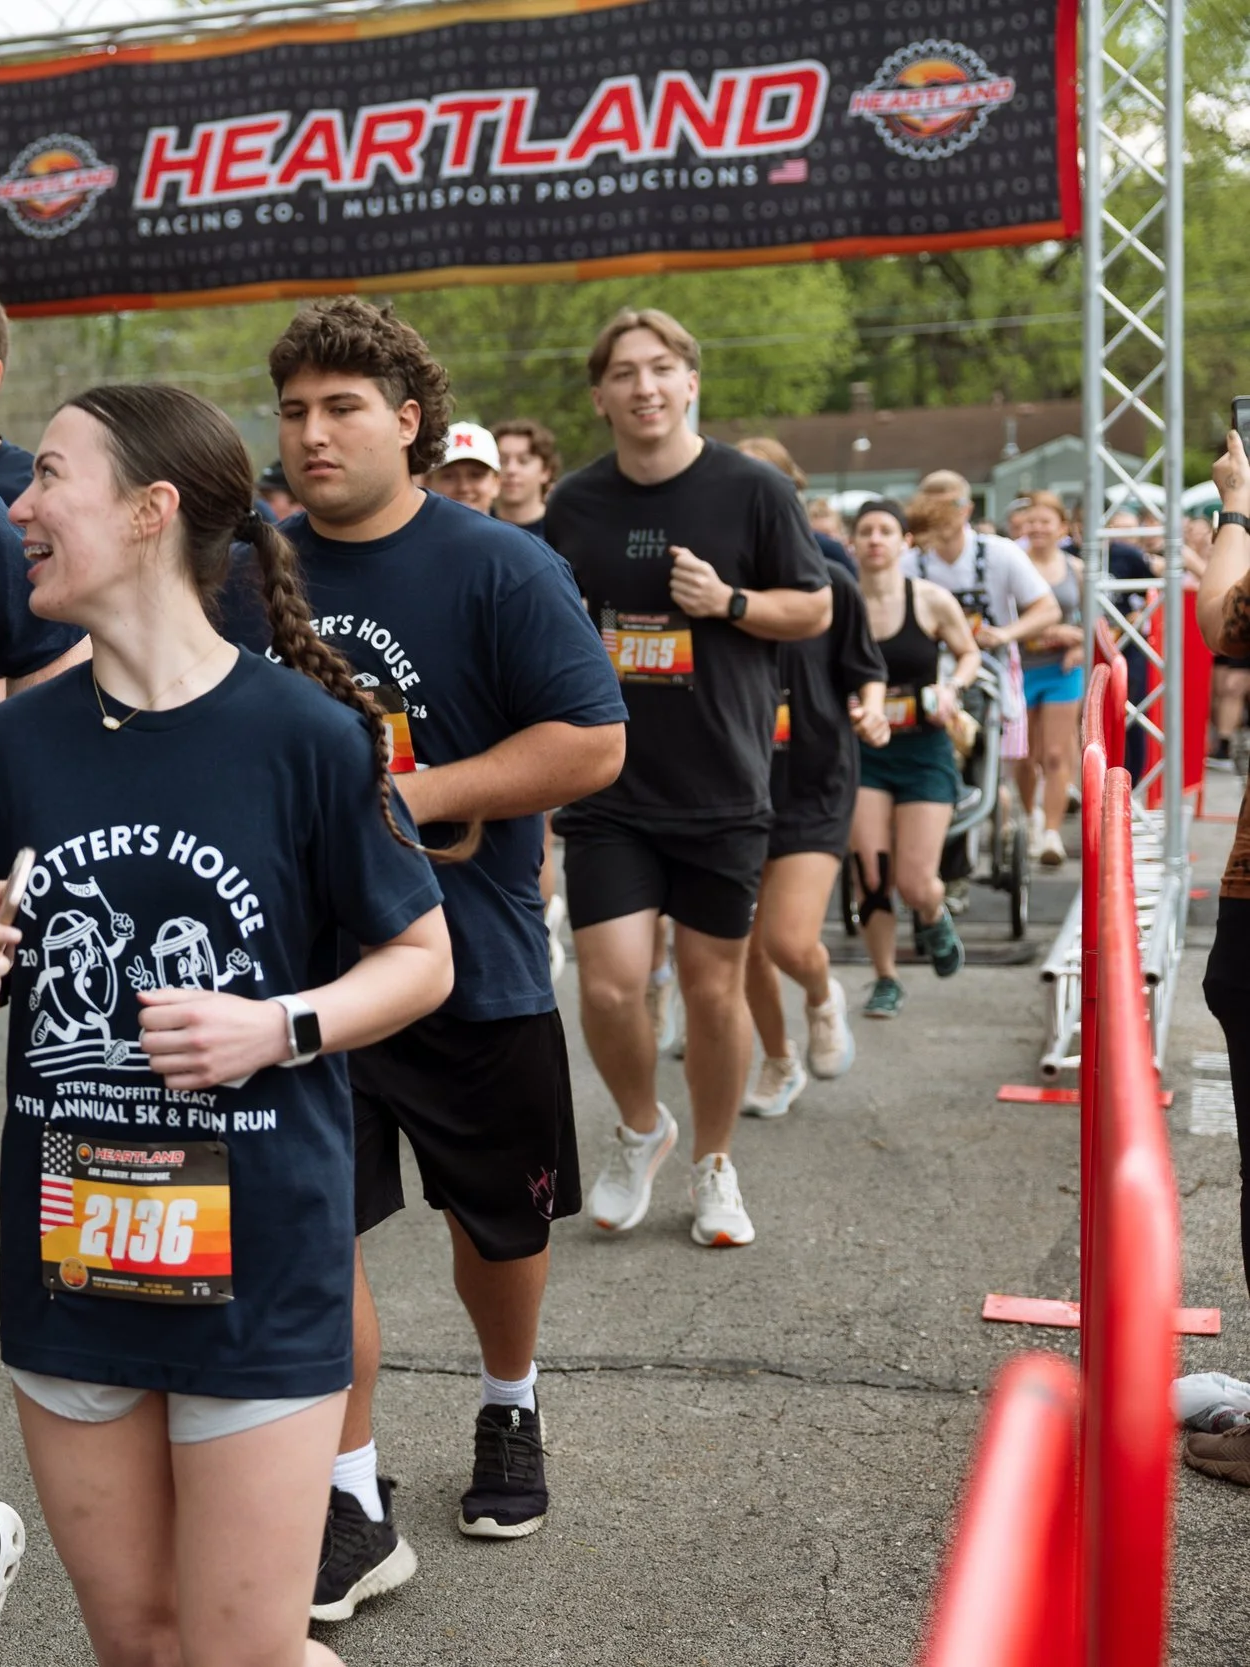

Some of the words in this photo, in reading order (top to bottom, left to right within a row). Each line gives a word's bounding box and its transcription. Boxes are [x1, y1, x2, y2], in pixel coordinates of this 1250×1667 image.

[849, 76, 1016, 116] HEARTLAND
[134, 60, 829, 208] HEARTLAND
[137, 208, 243, 237] RACING
[256, 202, 304, 225] CO.
[342, 184, 522, 220] MULTISPORT
[536, 164, 758, 202] PRODUCTIONS
[626, 544, 665, 559] CITY
[628, 529, 667, 543] HILL
[309, 614, 354, 637] ER'S
[356, 618, 421, 691] HOUSE
[619, 636, 676, 669] 2165
[411, 704, 428, 719] 26
[20, 824, 160, 920] POTTER'S
[168, 830, 265, 939] HOUSE
[18, 949, 38, 967] 20
[56, 1081, 96, 1096] STEVE
[99, 1083, 161, 1101] PROFFITT
[164, 1088, 217, 1108] LEGACY
[14, 1094, 45, 1117] 4TH
[50, 1099, 129, 1124] ANNUAL
[135, 1105, 161, 1126] 5K
[166, 1108, 181, 1127] &
[188, 1108, 227, 1132] FUN
[233, 1109, 277, 1132] RUN
[94, 1147, 185, 1164] HEARTLAND
[79, 1194, 197, 1265] 2136
